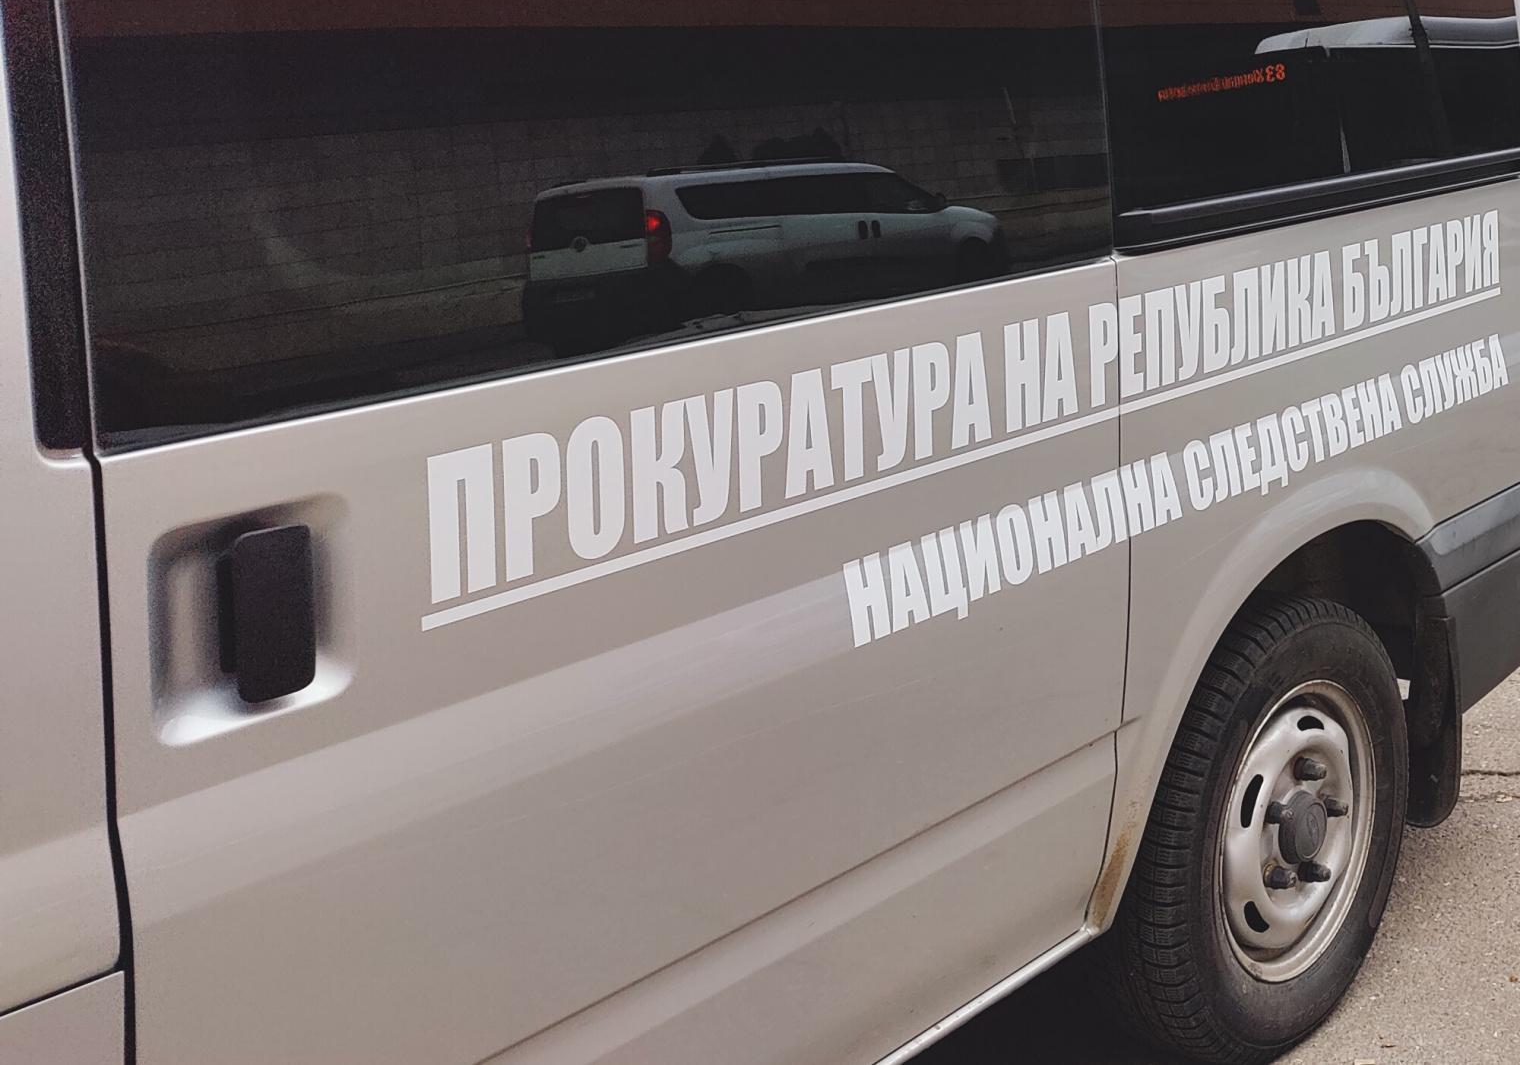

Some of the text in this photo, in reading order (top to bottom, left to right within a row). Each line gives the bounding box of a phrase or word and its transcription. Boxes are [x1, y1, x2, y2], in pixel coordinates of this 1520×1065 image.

[427, 210, 1500, 604] ПРОКУРАТУРА НА РЕПУБЛИКА БЪЛГАРИЯ
[843, 333, 1510, 648] НАЦИОНАЛНА СЛЕДСТВЕНА СЛУЖБА
